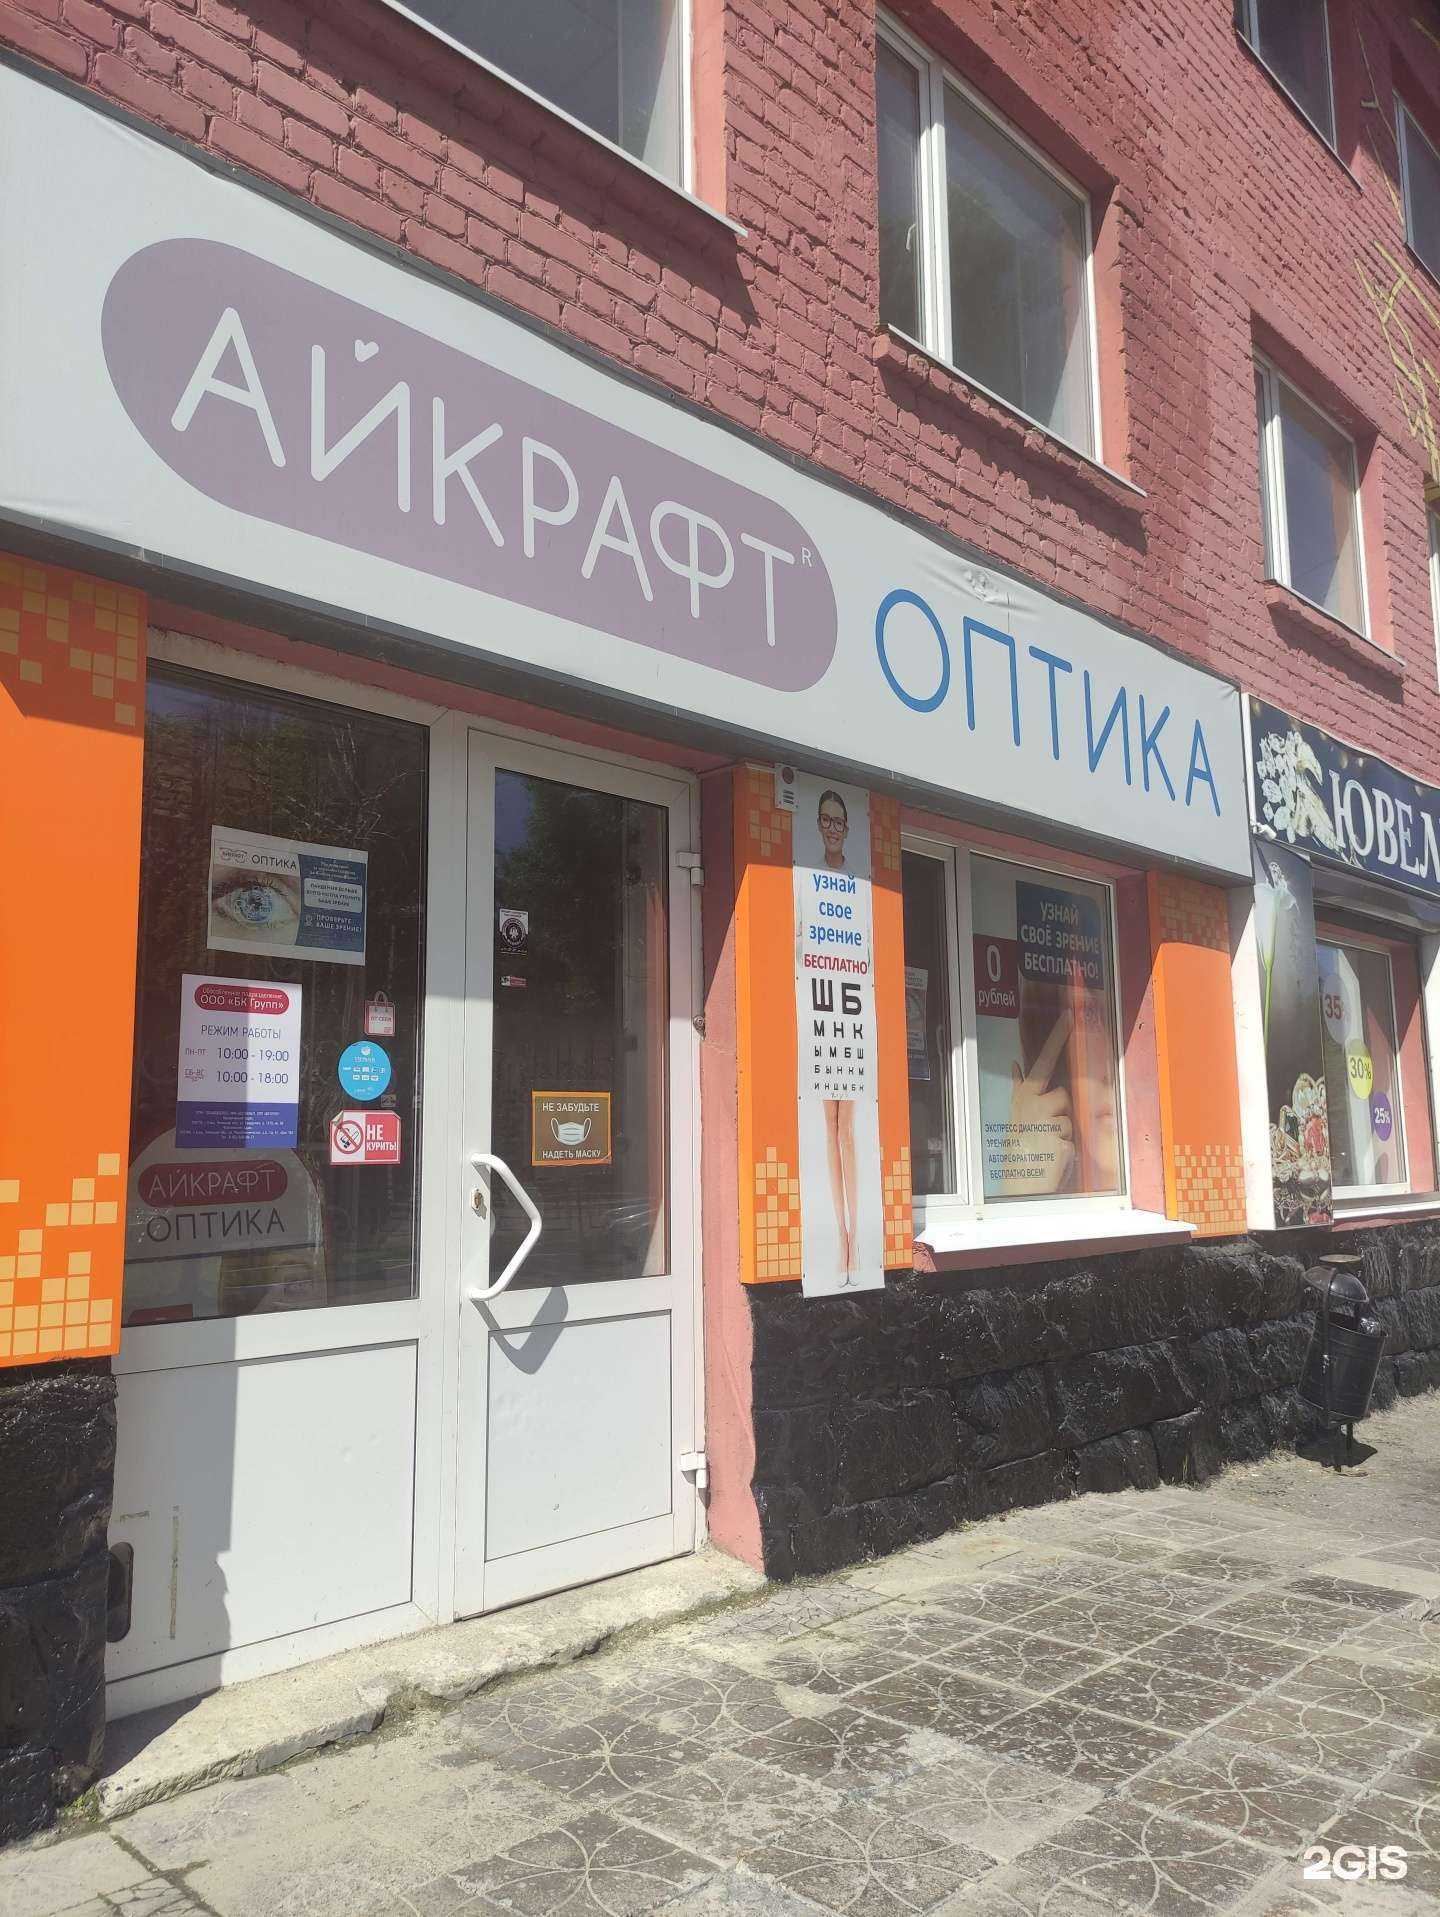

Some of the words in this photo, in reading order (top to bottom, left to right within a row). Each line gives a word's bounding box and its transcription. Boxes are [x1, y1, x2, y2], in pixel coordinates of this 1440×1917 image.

[171, 306, 795, 647] АЙКРАФТ
[875, 588, 1222, 817] ОПТИКА
[251, 854, 297, 870] ОПТИКА
[812, 872, 856, 894] узнай
[818, 900, 852, 920] свое
[1040, 901, 1079, 925] УЗНАЙ
[808, 924, 862, 946] зрение
[1020, 924, 1053, 947] СВОЁ
[1055, 931, 1100, 954] ЗРЕНИЕ
[804, 953, 868, 975] БЕСПЛАТНО
[1023, 952, 1099, 979] БЕСПЛАТНО!
[200, 994, 225, 1005] ООО
[978, 988, 1016, 1008] рублей
[201, 1024, 240, 1037] РЕЖИМ
[242, 1026, 282, 1039] РАБОТЫ
[217, 1047, 249, 1060] 10:00
[260, 1049, 289, 1062] 19:00
[217, 1070, 248, 1083] 10:00
[259, 1072, 289, 1084] 18:00
[1350, 1056, 1373, 1081] 30%
[542, 1102, 555, 1112] НЕ
[556, 1102, 600, 1113] ЗАБУДЬТЕ
[1373, 1107, 1391, 1124] 25%
[366, 1124, 384, 1140] НЕ
[984, 1123, 1018, 1133] ЭКСПРЕСС
[1018, 1123, 1062, 1134] ДИАГНОСТИКА
[366, 1141, 398, 1152] КУРИТЬ!
[542, 1149, 574, 1160] НАДЕТЬ
[576, 1149, 601, 1159] МАСКУ
[148, 1167, 276, 1199] АЙКРАФТ
[146, 1207, 286, 1243] ОПТИКА
